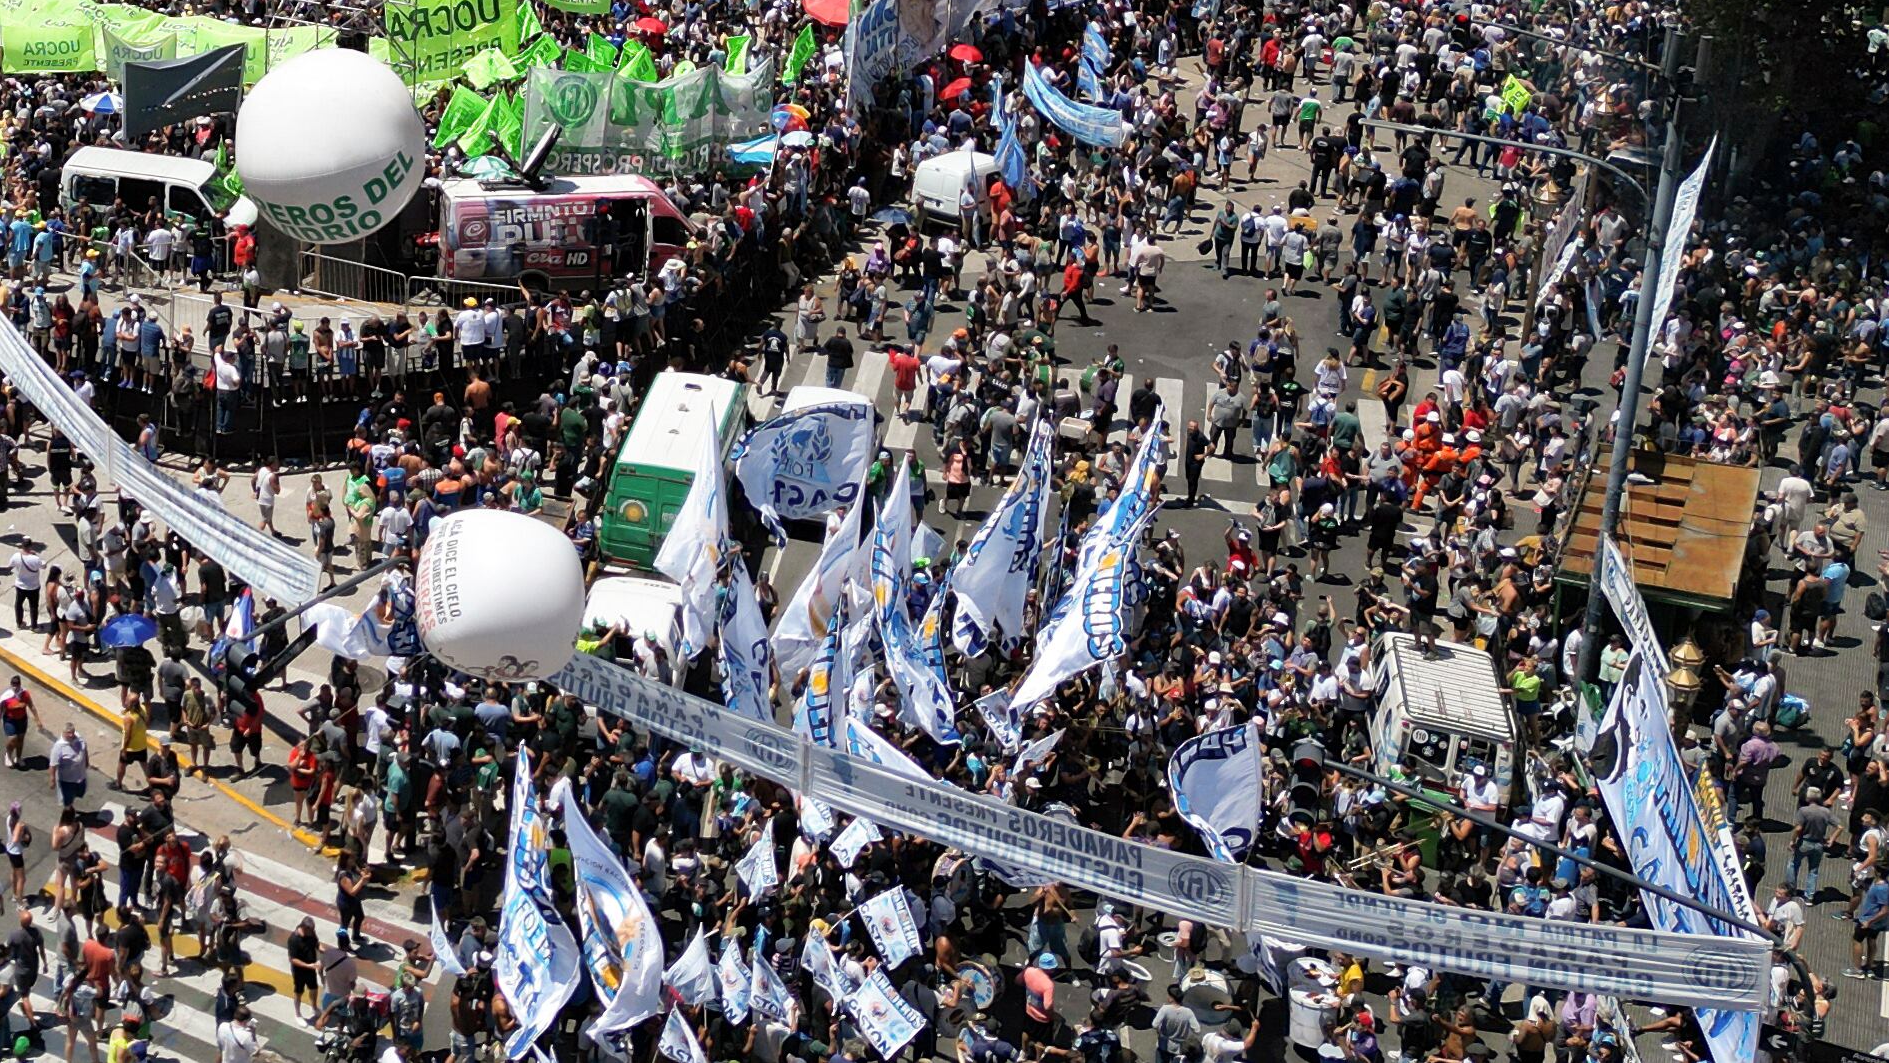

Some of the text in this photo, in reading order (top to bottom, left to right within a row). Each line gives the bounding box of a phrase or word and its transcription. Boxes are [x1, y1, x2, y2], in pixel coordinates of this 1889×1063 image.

[364, 151, 415, 206] DEL
[566, 250, 589, 267] HD
[445, 566, 457, 582] EL
[446, 539, 458, 564] DICE
[432, 557, 448, 626] SUBESTIMES
[859, 902, 891, 966] GASTON
[849, 998, 891, 1055] GASTON
